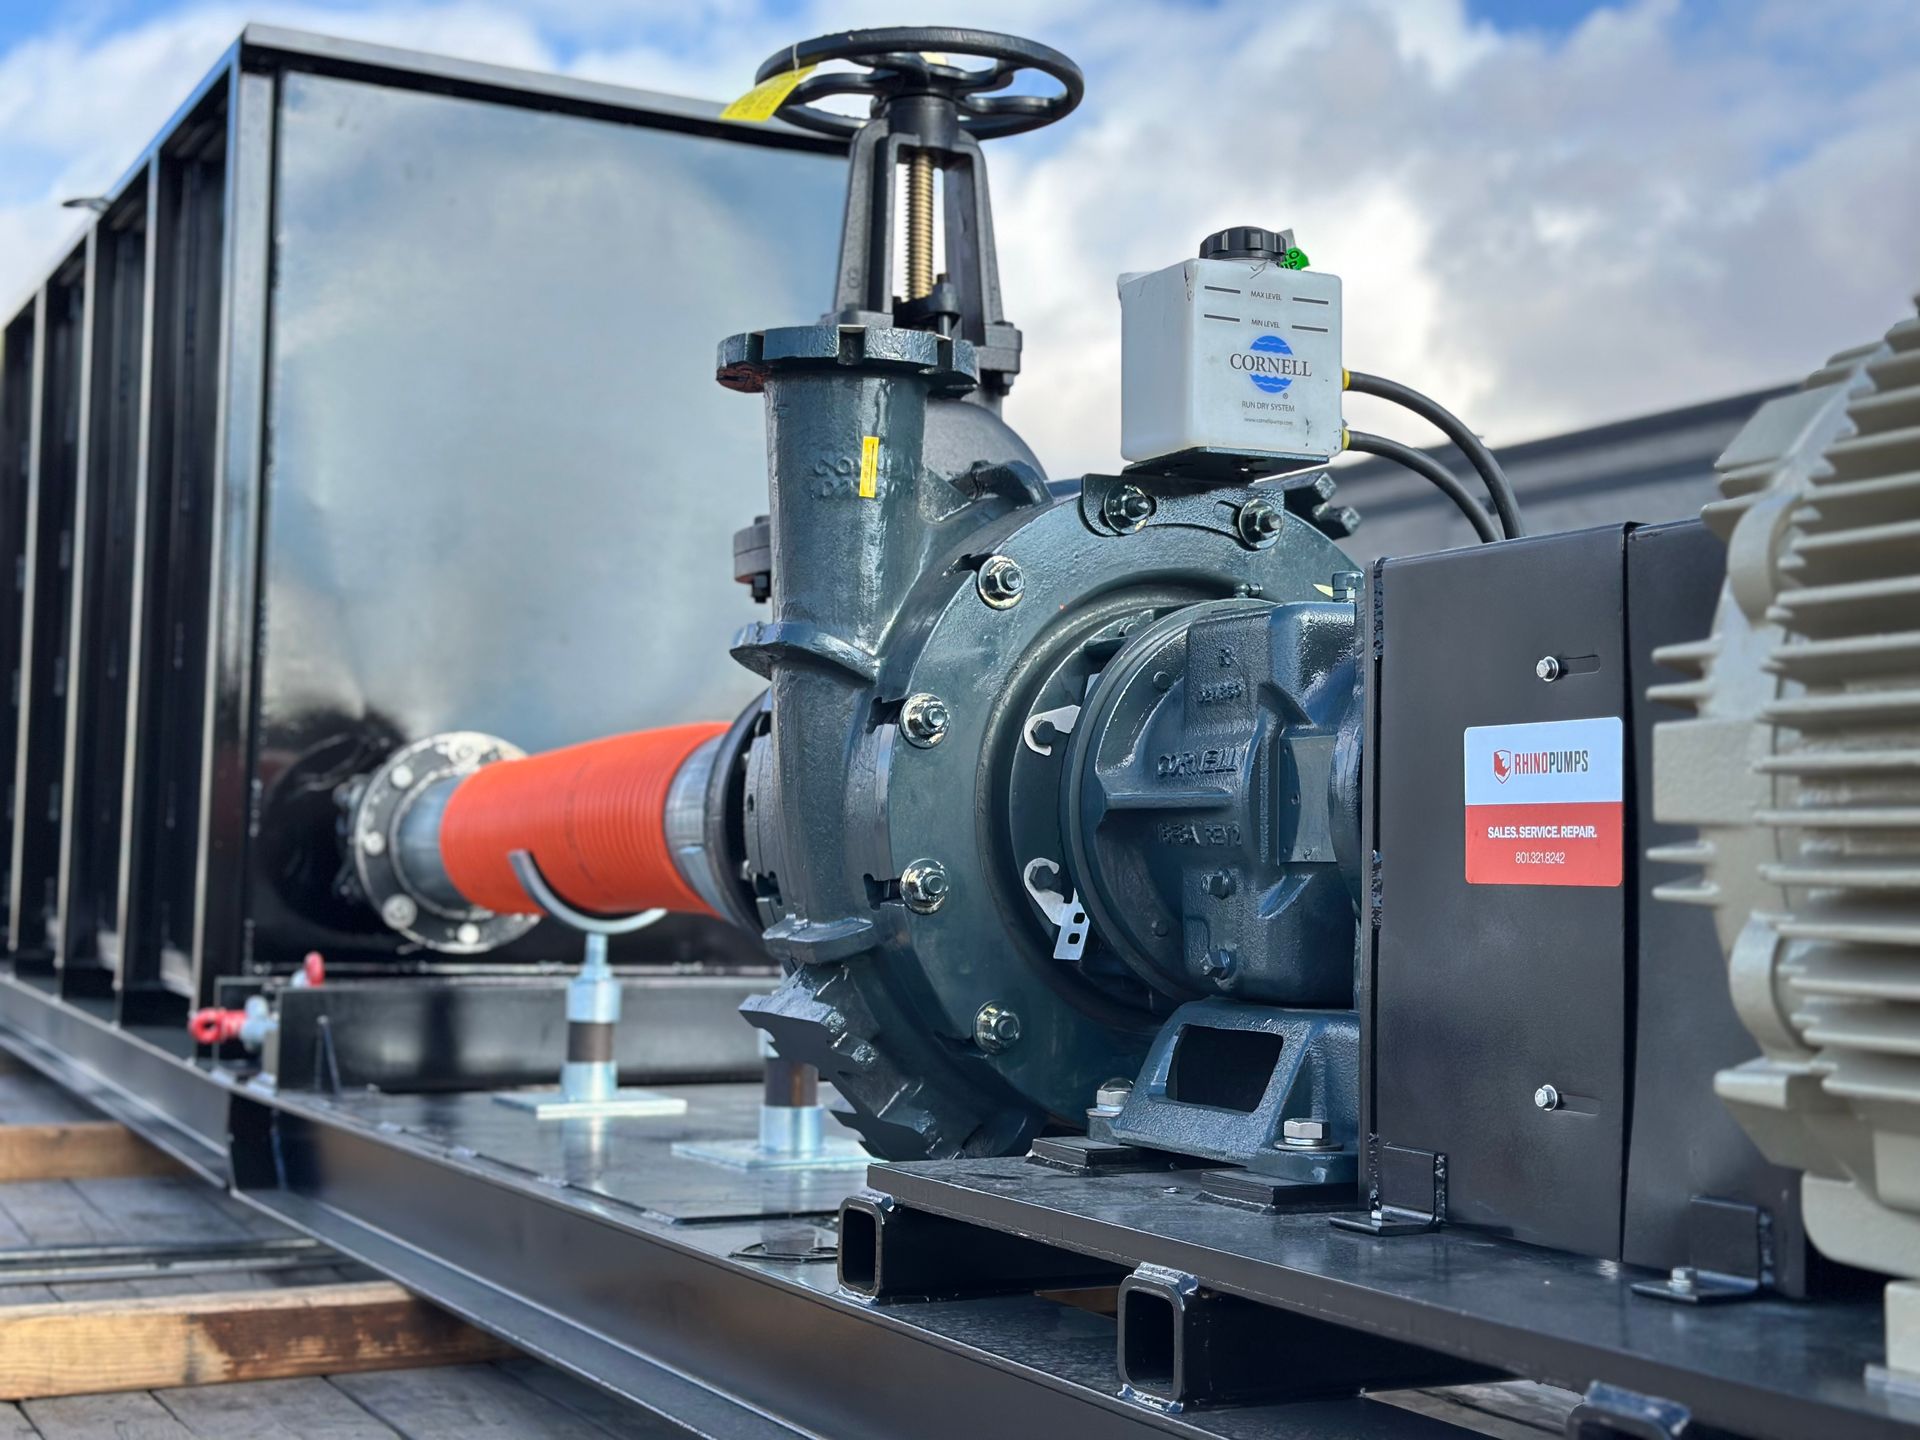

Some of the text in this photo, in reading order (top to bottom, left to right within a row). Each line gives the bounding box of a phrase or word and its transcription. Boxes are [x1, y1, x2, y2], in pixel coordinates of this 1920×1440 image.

[1250, 290, 1282, 301] MAX LEVEL
[1251, 319, 1280, 329] MIN LEVEL
[1230, 353, 1312, 377] CORNELL
[1241, 400, 1295, 412] RUN DRY SYSTEM
[1514, 750, 1589, 775] RHINOPUMPS
[1487, 825, 1598, 839] SALES. SERVICE. REPAIR.
